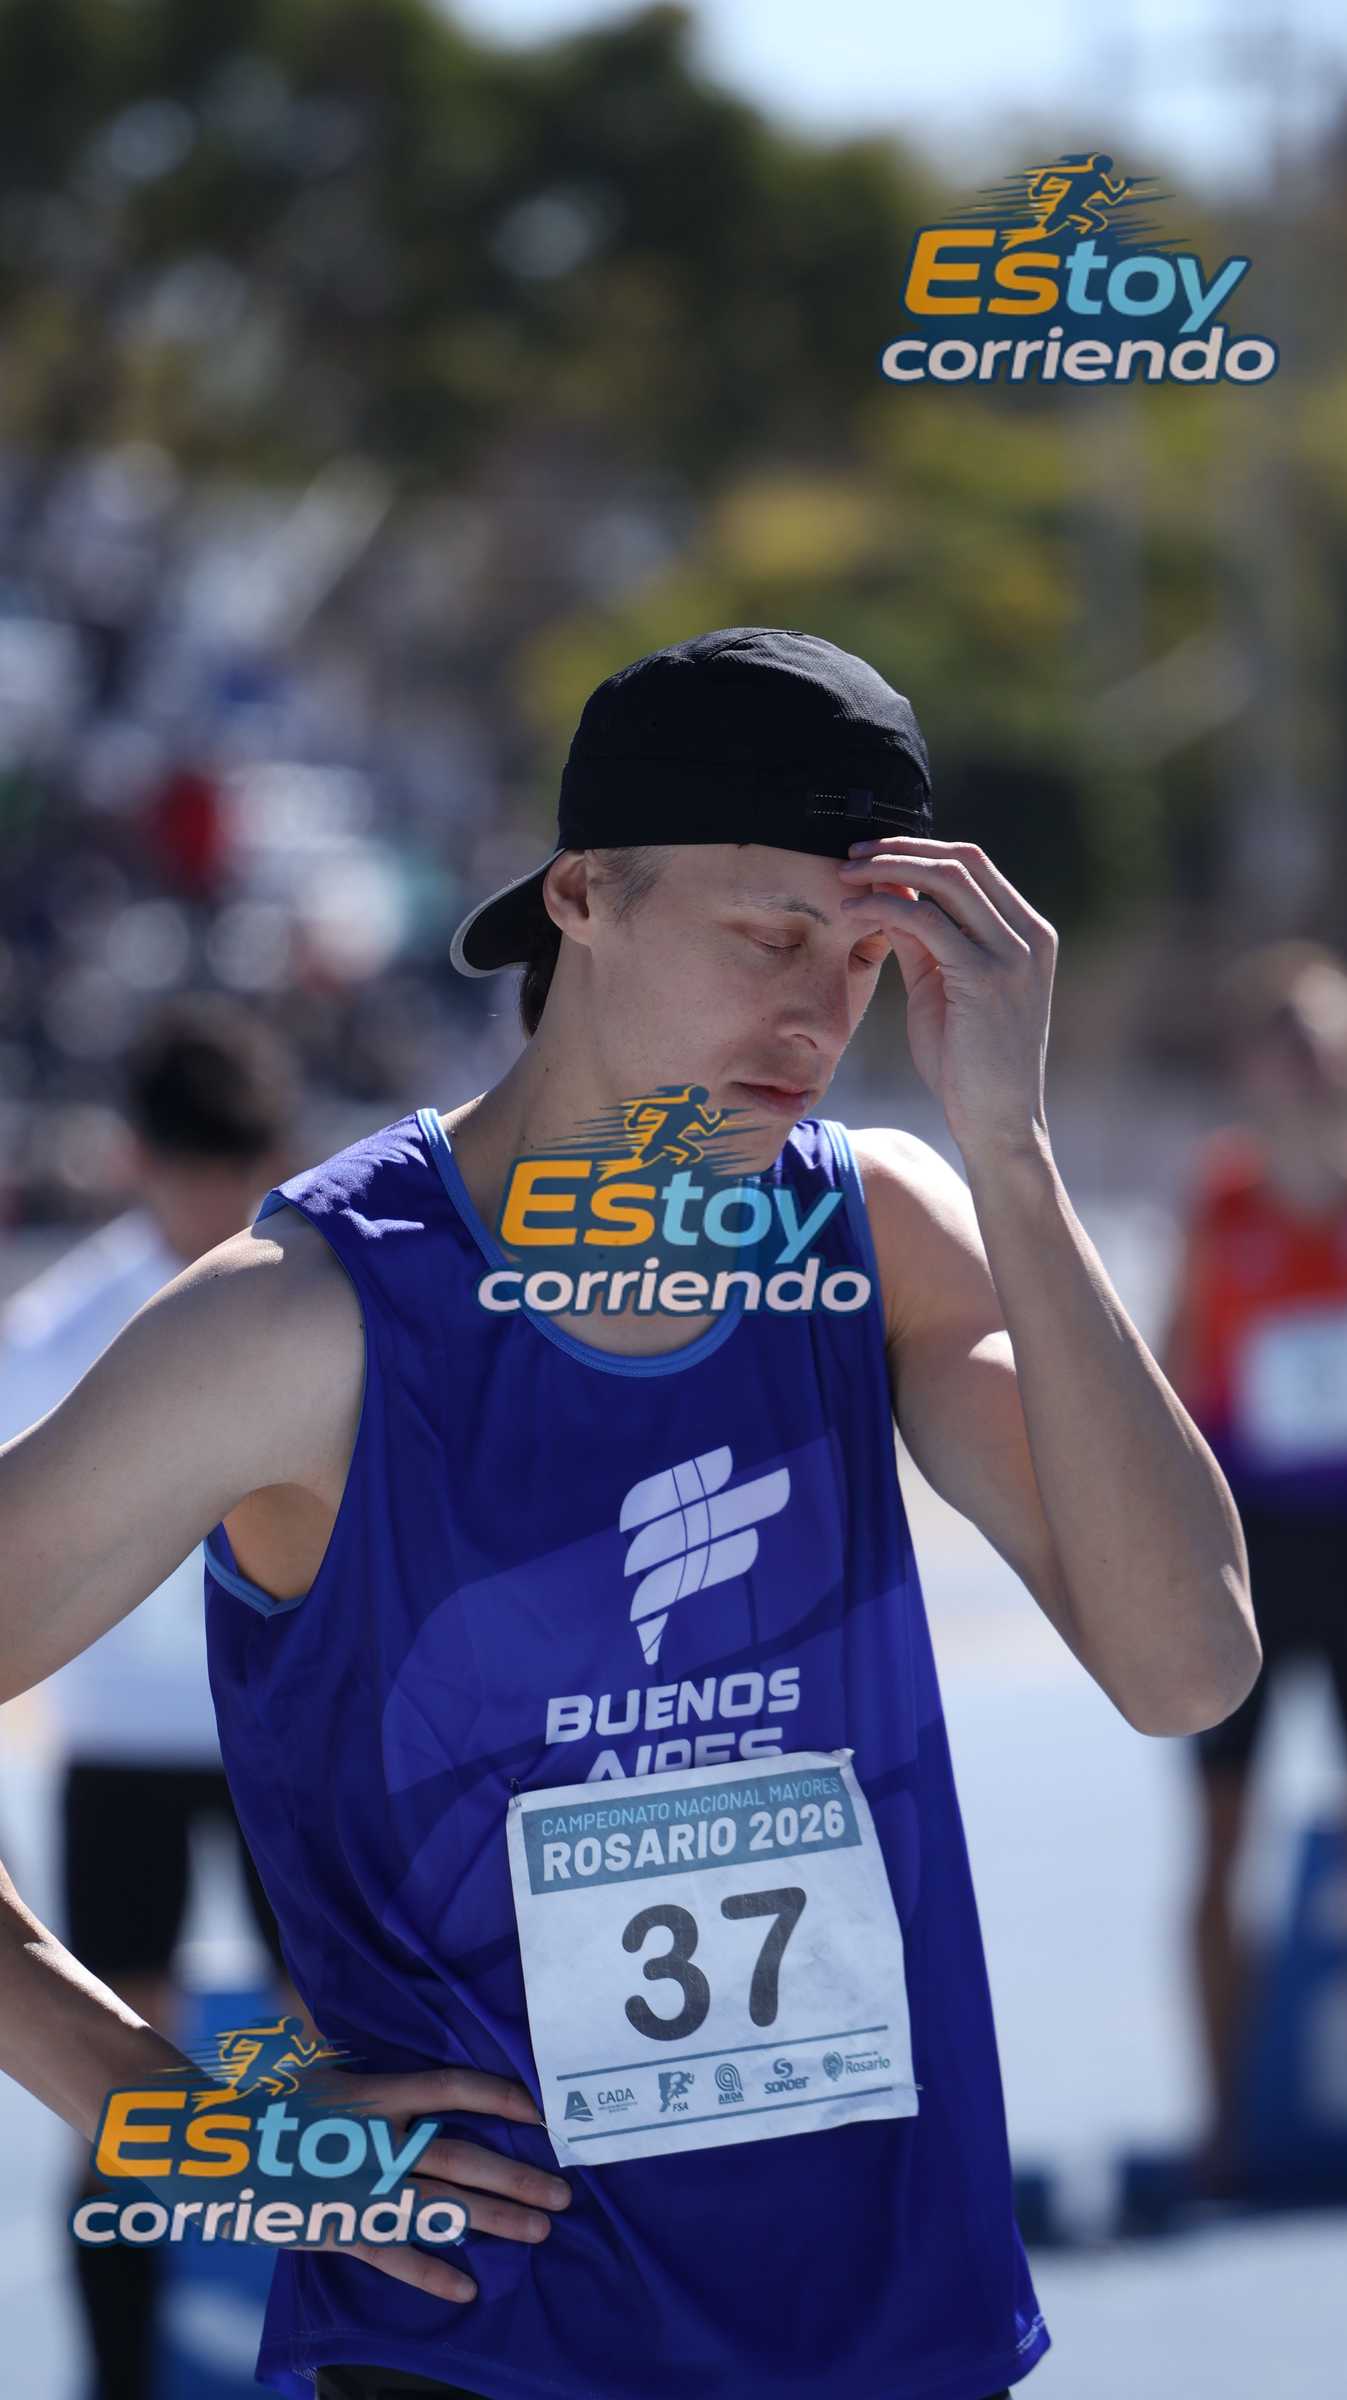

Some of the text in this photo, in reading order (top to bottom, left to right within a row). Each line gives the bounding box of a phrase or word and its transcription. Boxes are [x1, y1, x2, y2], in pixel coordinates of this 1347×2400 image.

[545, 1667, 800, 1745] BUENOS
[541, 1777, 840, 1837] CAMPEONATO NACIONAL MAYORES
[543, 1800, 846, 1882] ROSARIO 2026
[622, 1886, 807, 2041] 37
[597, 2087, 635, 2106] CADA
[845, 2056, 891, 2074] Rosario
